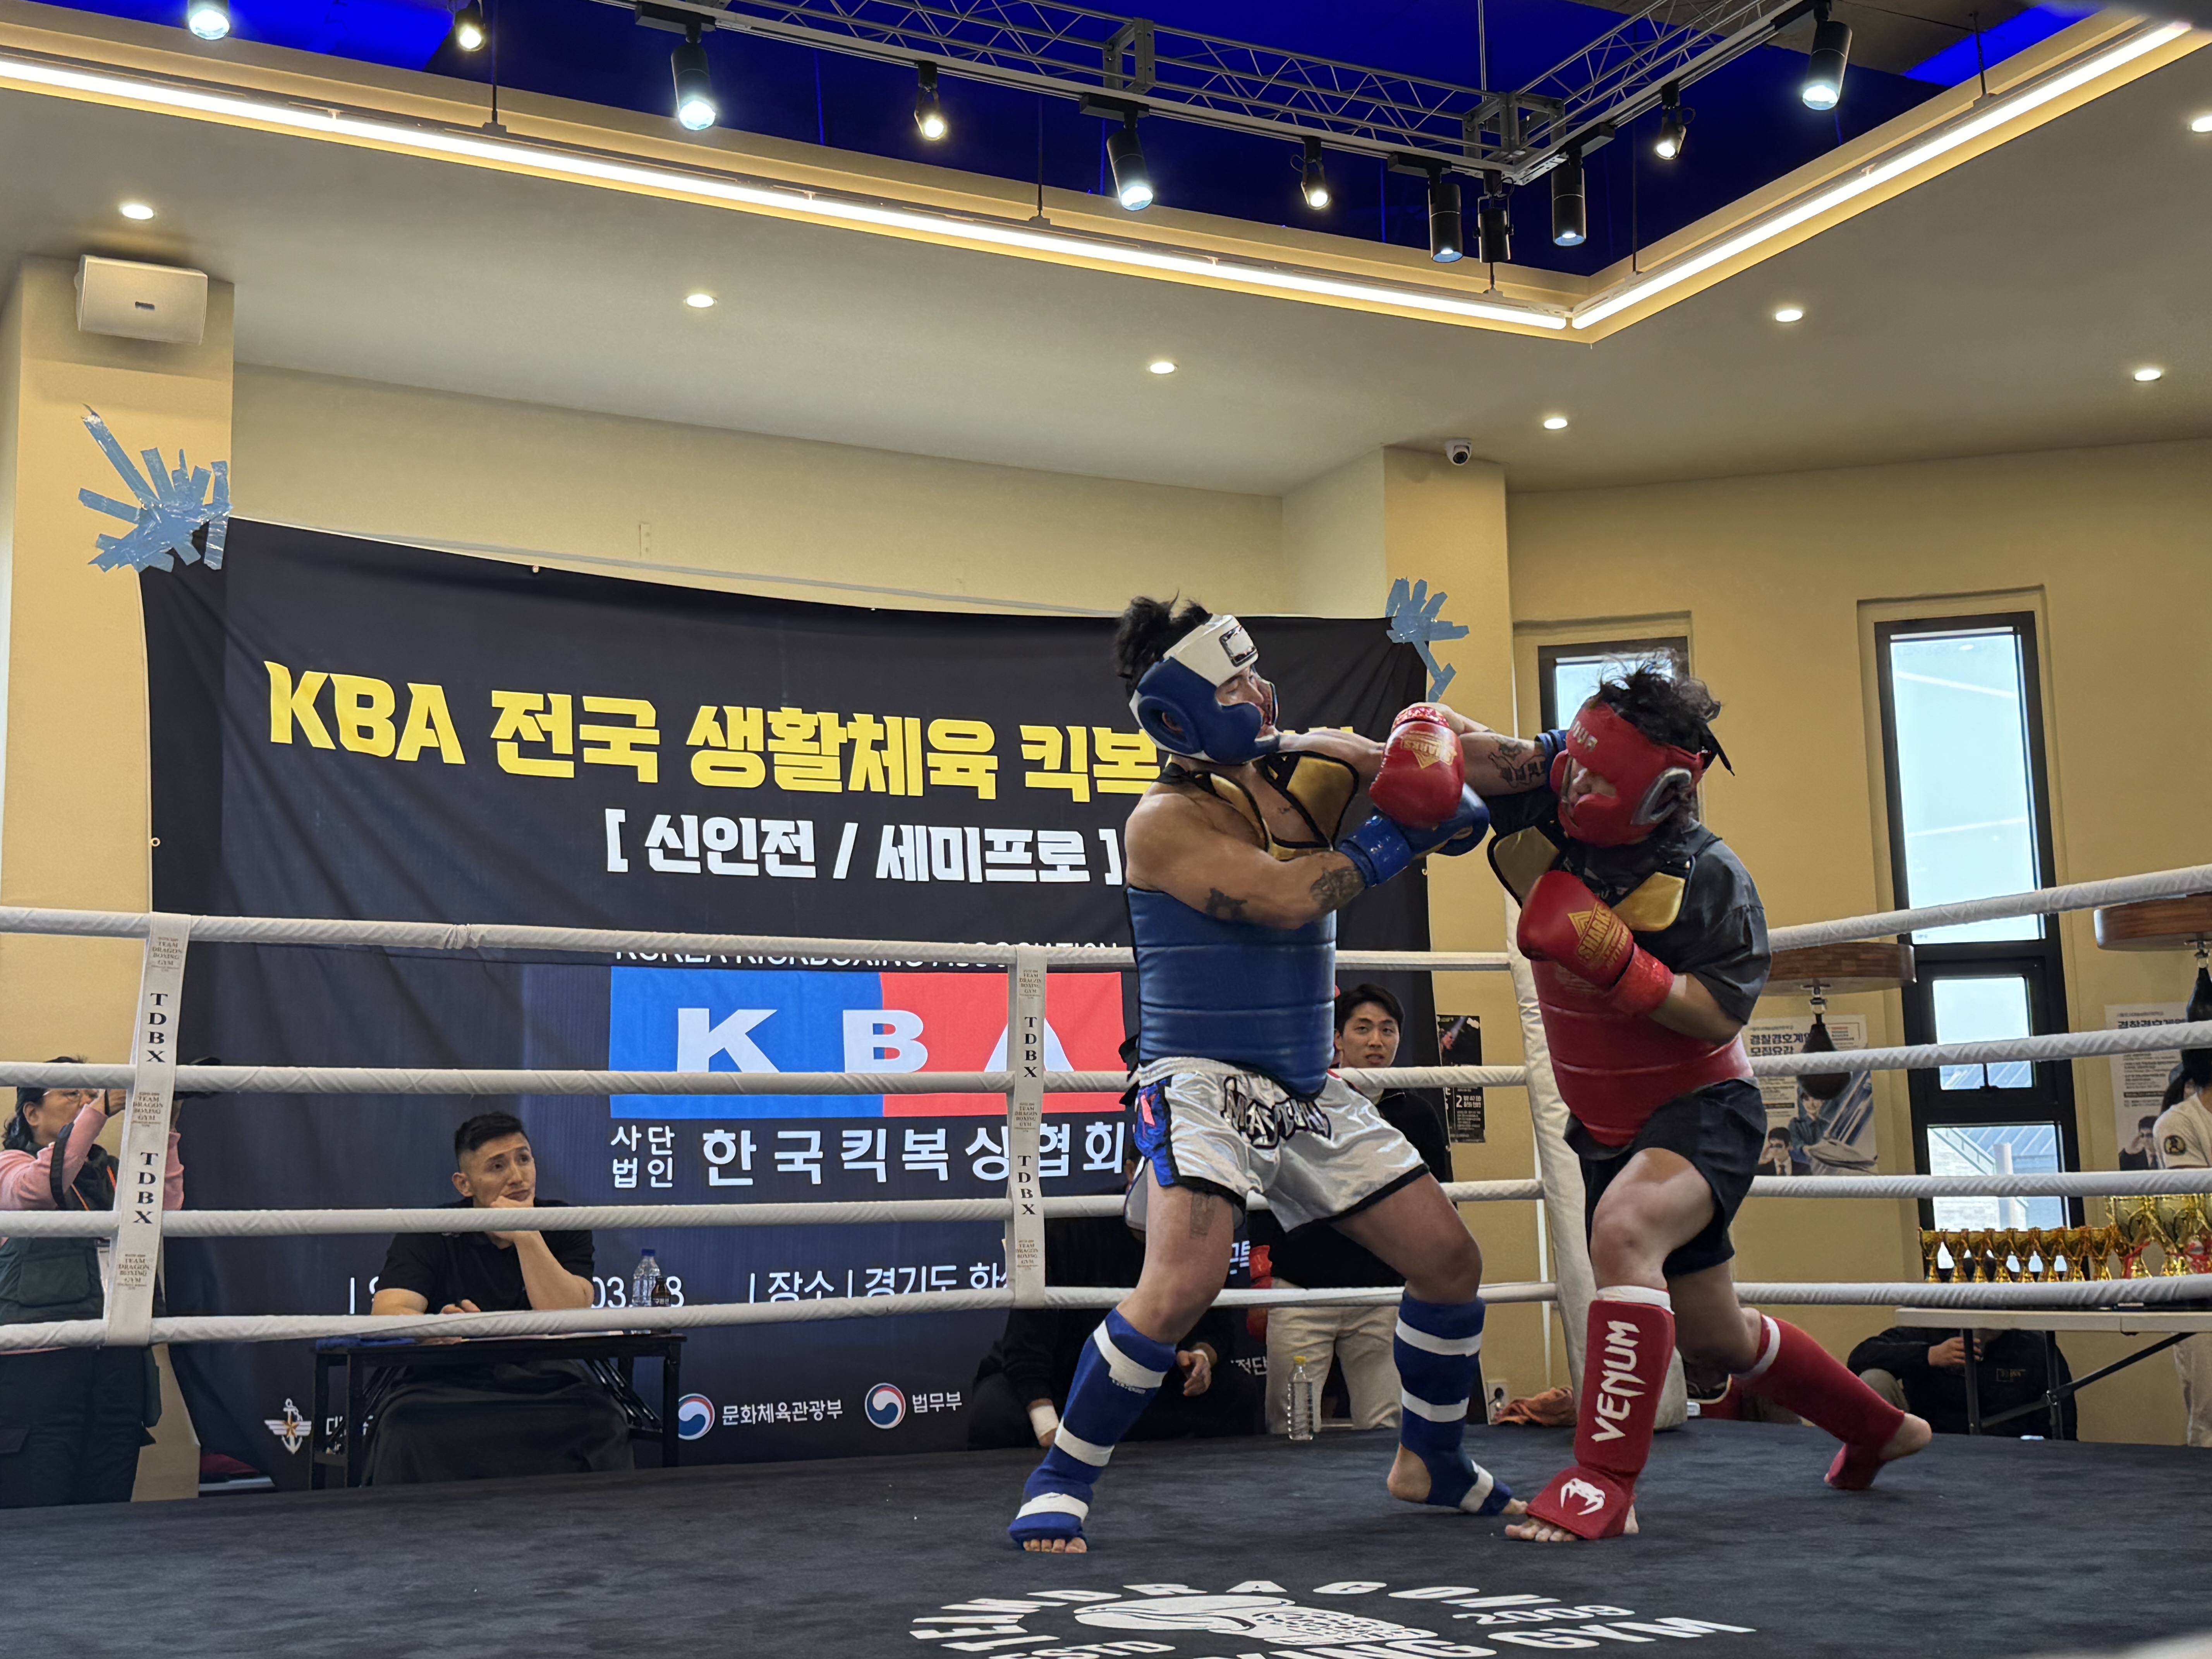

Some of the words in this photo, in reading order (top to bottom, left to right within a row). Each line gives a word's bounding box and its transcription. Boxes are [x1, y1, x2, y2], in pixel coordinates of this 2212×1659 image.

[266, 661, 465, 764] KBA
[491, 690, 660, 783] 전국
[687, 706, 998, 800] 생활체육
[1020, 725, 1172, 802] 킥복
[646, 814, 816, 878] 신인전
[876, 825, 1091, 883] 세미프로
[1578, 905, 1613, 960] SHARKS
[611, 1125, 675, 1156] 사단
[613, 1157, 673, 1188] 법인
[1591, 1320, 1647, 1442] VENUM
[722, 1399, 843, 1426] 문화체육관광부
[912, 1391, 963, 1413] 법무부
[1452, 1605, 1635, 1625] 2009
[1488, 1617, 1757, 1649] GYM
